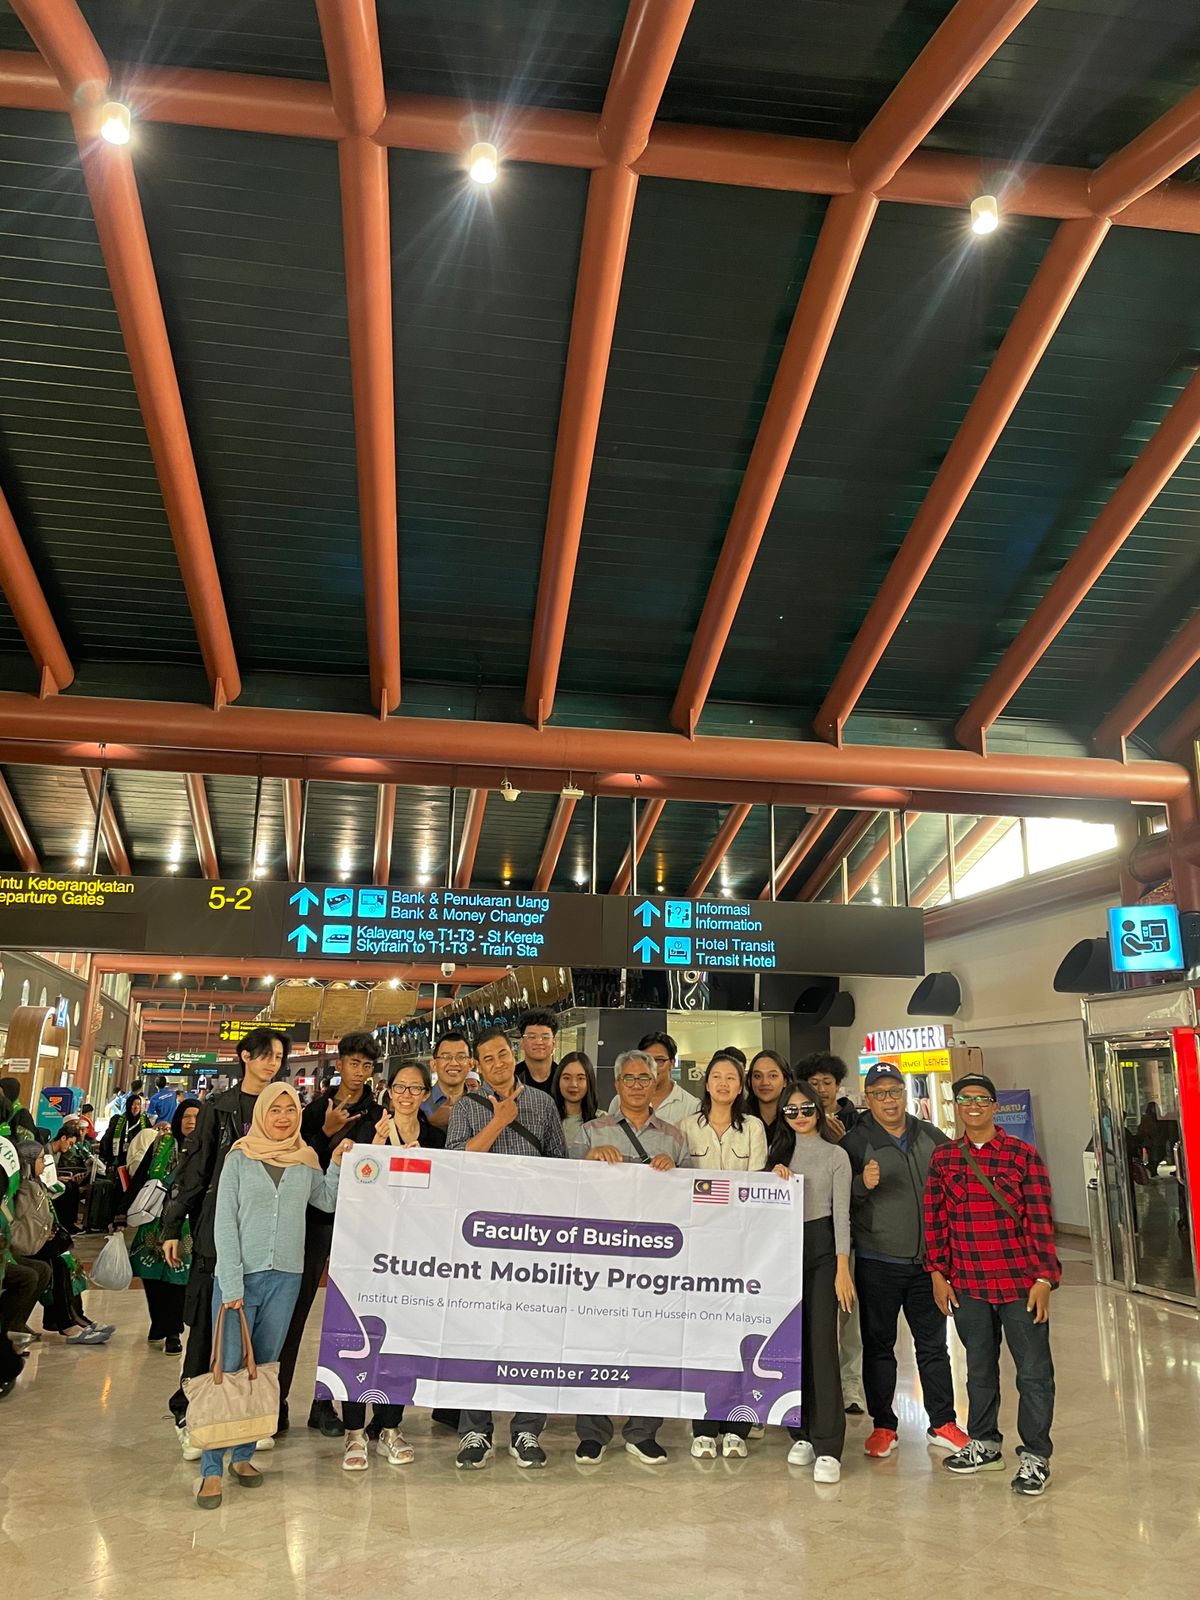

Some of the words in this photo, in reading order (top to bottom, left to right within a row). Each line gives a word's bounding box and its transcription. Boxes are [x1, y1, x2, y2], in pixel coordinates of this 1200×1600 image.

[28, 876, 134, 894] Keberangkatan
[0, 891, 57, 906] eparture
[62, 892, 104, 906] Gates
[208, 886, 252, 911] 5-2
[391, 891, 425, 905] Bank
[429, 893, 439, 905] &
[443, 893, 512, 908] Penukaran
[516, 896, 550, 911] Uang
[390, 907, 424, 920] Bank
[429, 908, 438, 920] &
[443, 909, 486, 924] Money
[490, 910, 544, 926] Changer
[695, 902, 750, 916] Informasi
[695, 917, 762, 932] Information
[356, 925, 415, 942] Kalayang
[419, 928, 434, 941] ke
[438, 928, 474, 942] T1-T3
[487, 930, 502, 943] St
[505, 931, 544, 945] Kereta
[356, 940, 409, 954] Skytrain
[413, 941, 425, 953] to
[429, 941, 468, 955] T1-T3
[480, 942, 513, 956] Train
[516, 944, 538, 957] Sta
[695, 938, 728, 951] Hotel
[732, 939, 775, 952] Transit
[695, 953, 740, 967] Transit
[743, 955, 776, 968] Hotel
[878, 1026, 936, 1052] MONSTER
[751, 1187, 791, 1201] UTHM
[472, 1221, 551, 1246] Faculty
[556, 1226, 579, 1244] of
[583, 1228, 674, 1250] Business
[372, 1253, 482, 1280] Student
[490, 1260, 600, 1291] Mobility
[607, 1268, 762, 1295] Programme
[357, 1292, 398, 1305] Institut
[401, 1295, 434, 1308] Bisnis
[437, 1297, 445, 1308] &
[447, 1298, 513, 1312] Informatika
[515, 1301, 567, 1315] Kesatuan
[578, 1304, 629, 1318] Universiti
[632, 1308, 652, 1319] Tun
[655, 1309, 697, 1320] Hussein
[700, 1311, 723, 1322] Onn
[725, 1312, 772, 1326] Malaysia
[497, 1364, 584, 1381] November
[590, 1368, 631, 1382] 2024
